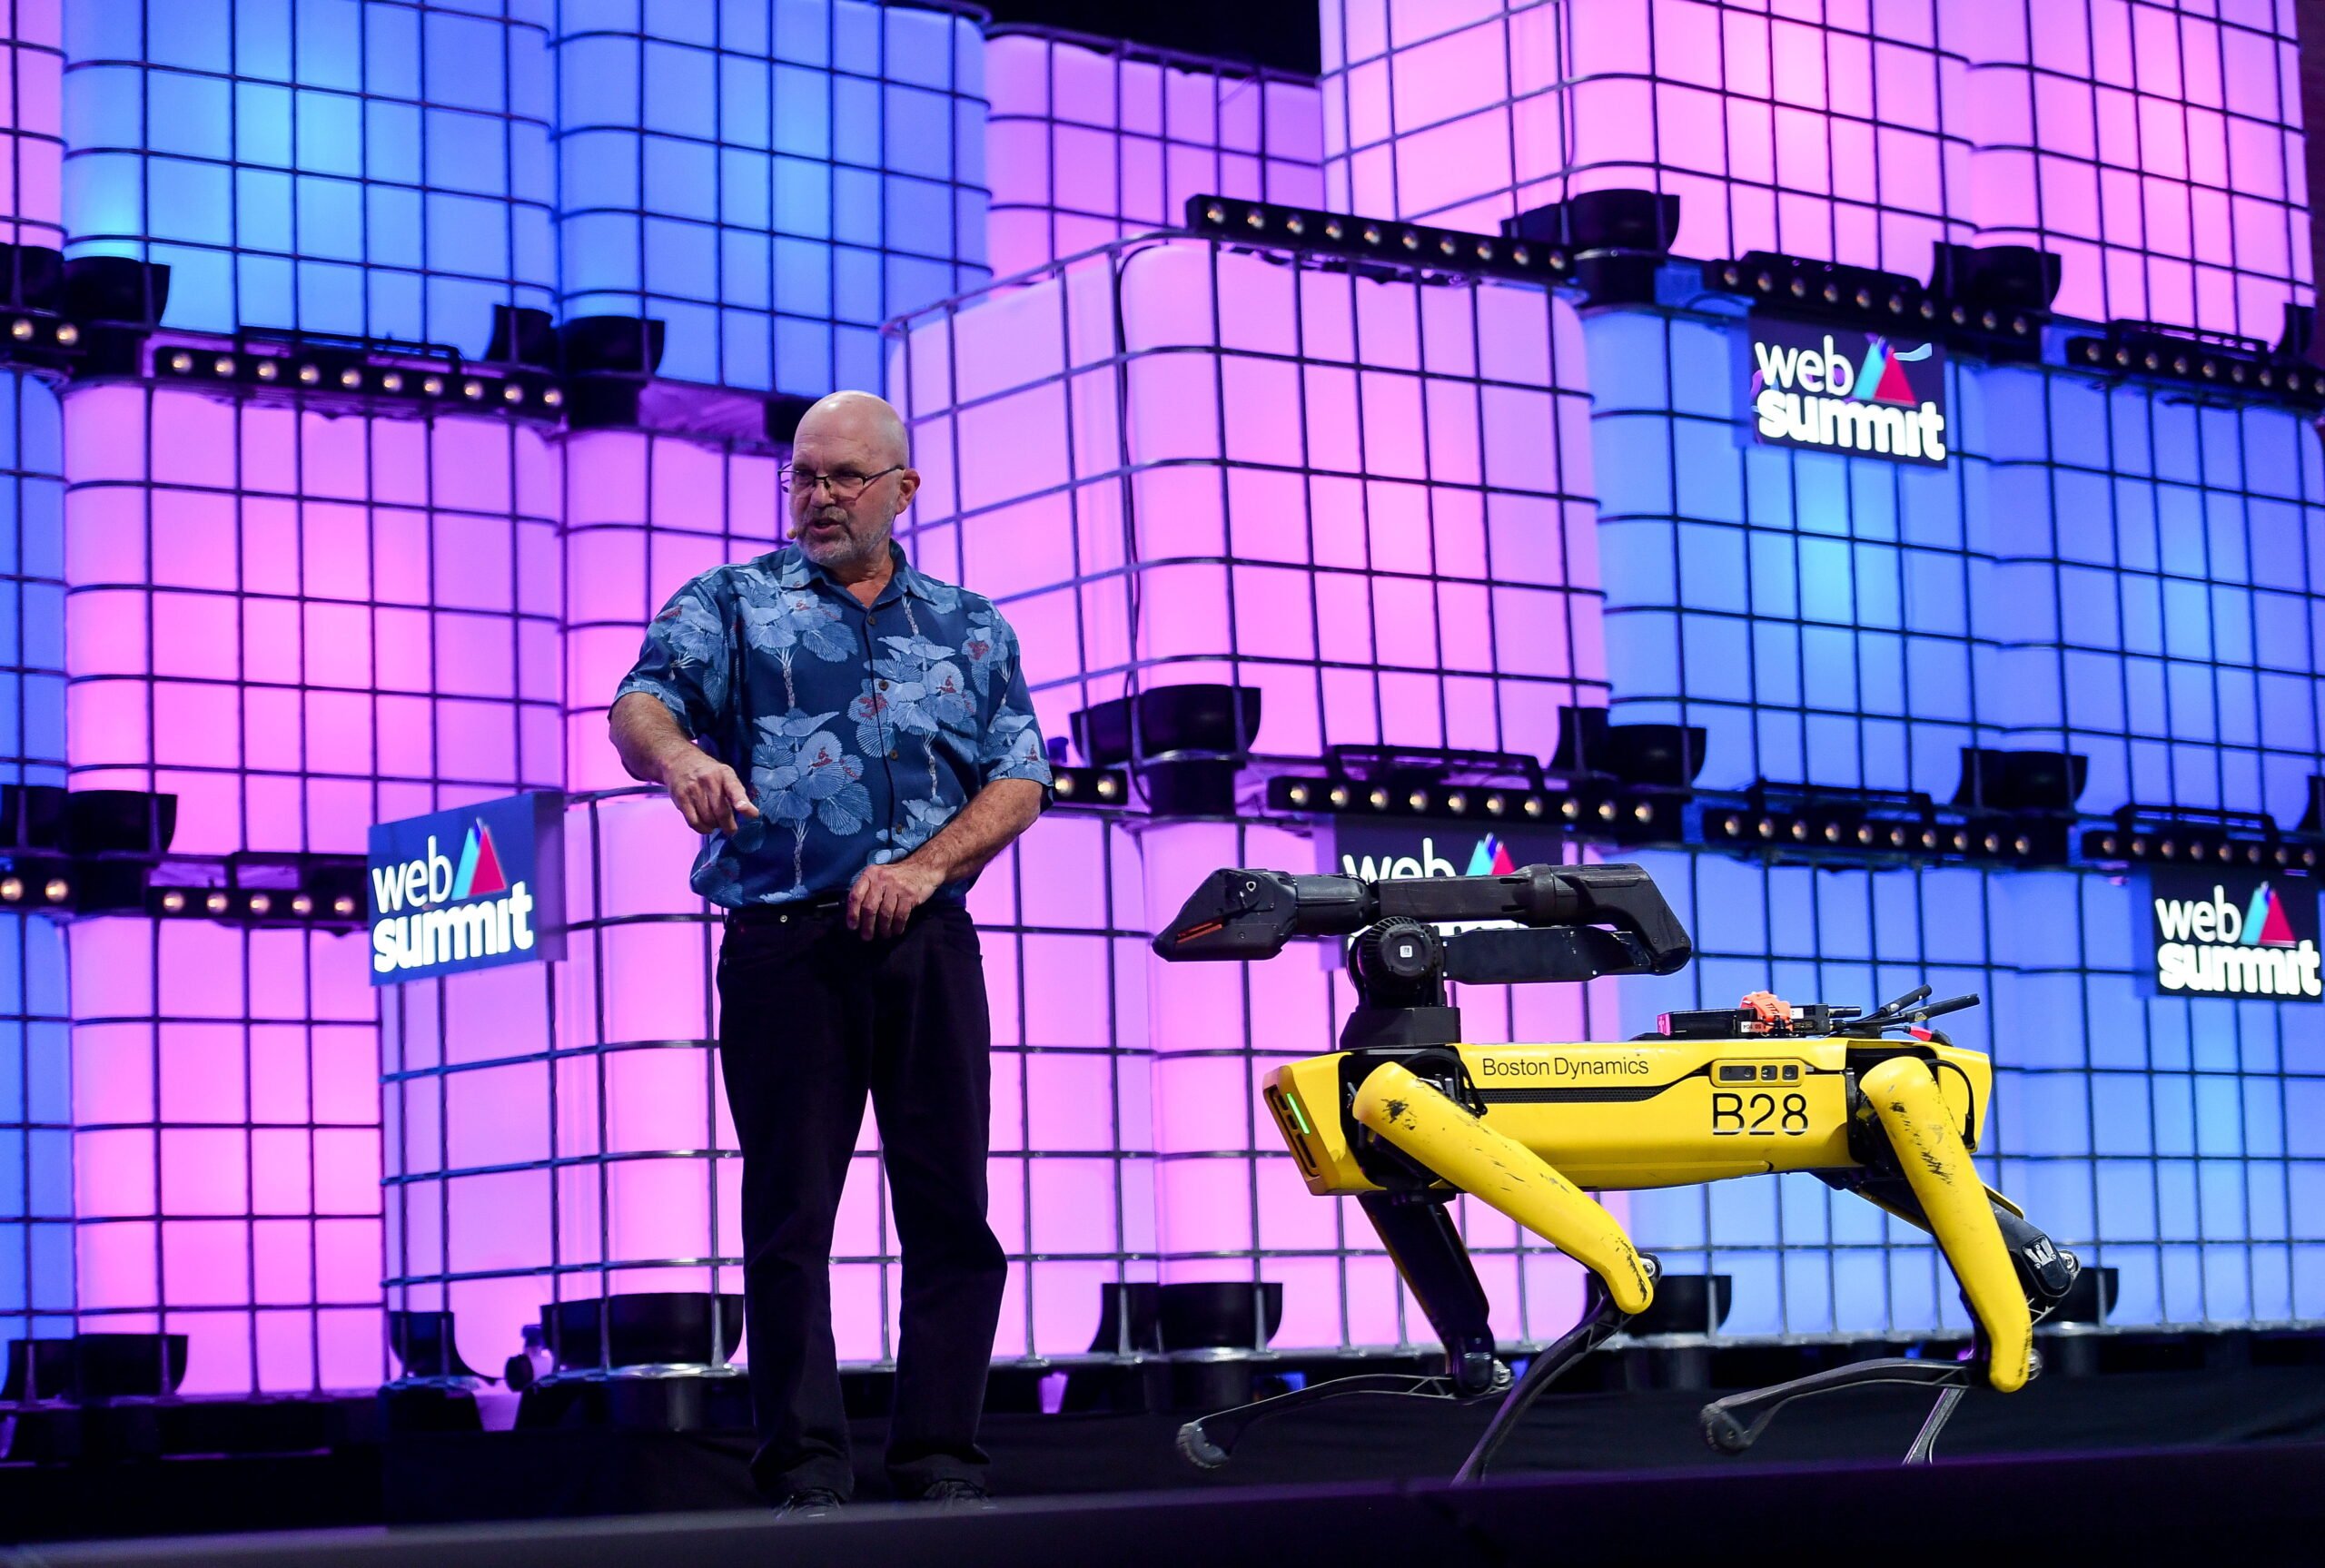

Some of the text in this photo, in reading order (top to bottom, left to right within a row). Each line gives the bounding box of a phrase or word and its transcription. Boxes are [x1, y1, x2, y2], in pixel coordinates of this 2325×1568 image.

[1755, 334, 1855, 397] web
[1756, 389, 1946, 461] summit
[371, 834, 453, 914] web
[372, 881, 535, 973] summit
[2154, 884, 2242, 943] web
[2157, 939, 2322, 997] summit
[1482, 1057, 1649, 1080] Boston Dynamics
[1712, 1092, 1808, 1137] B28
